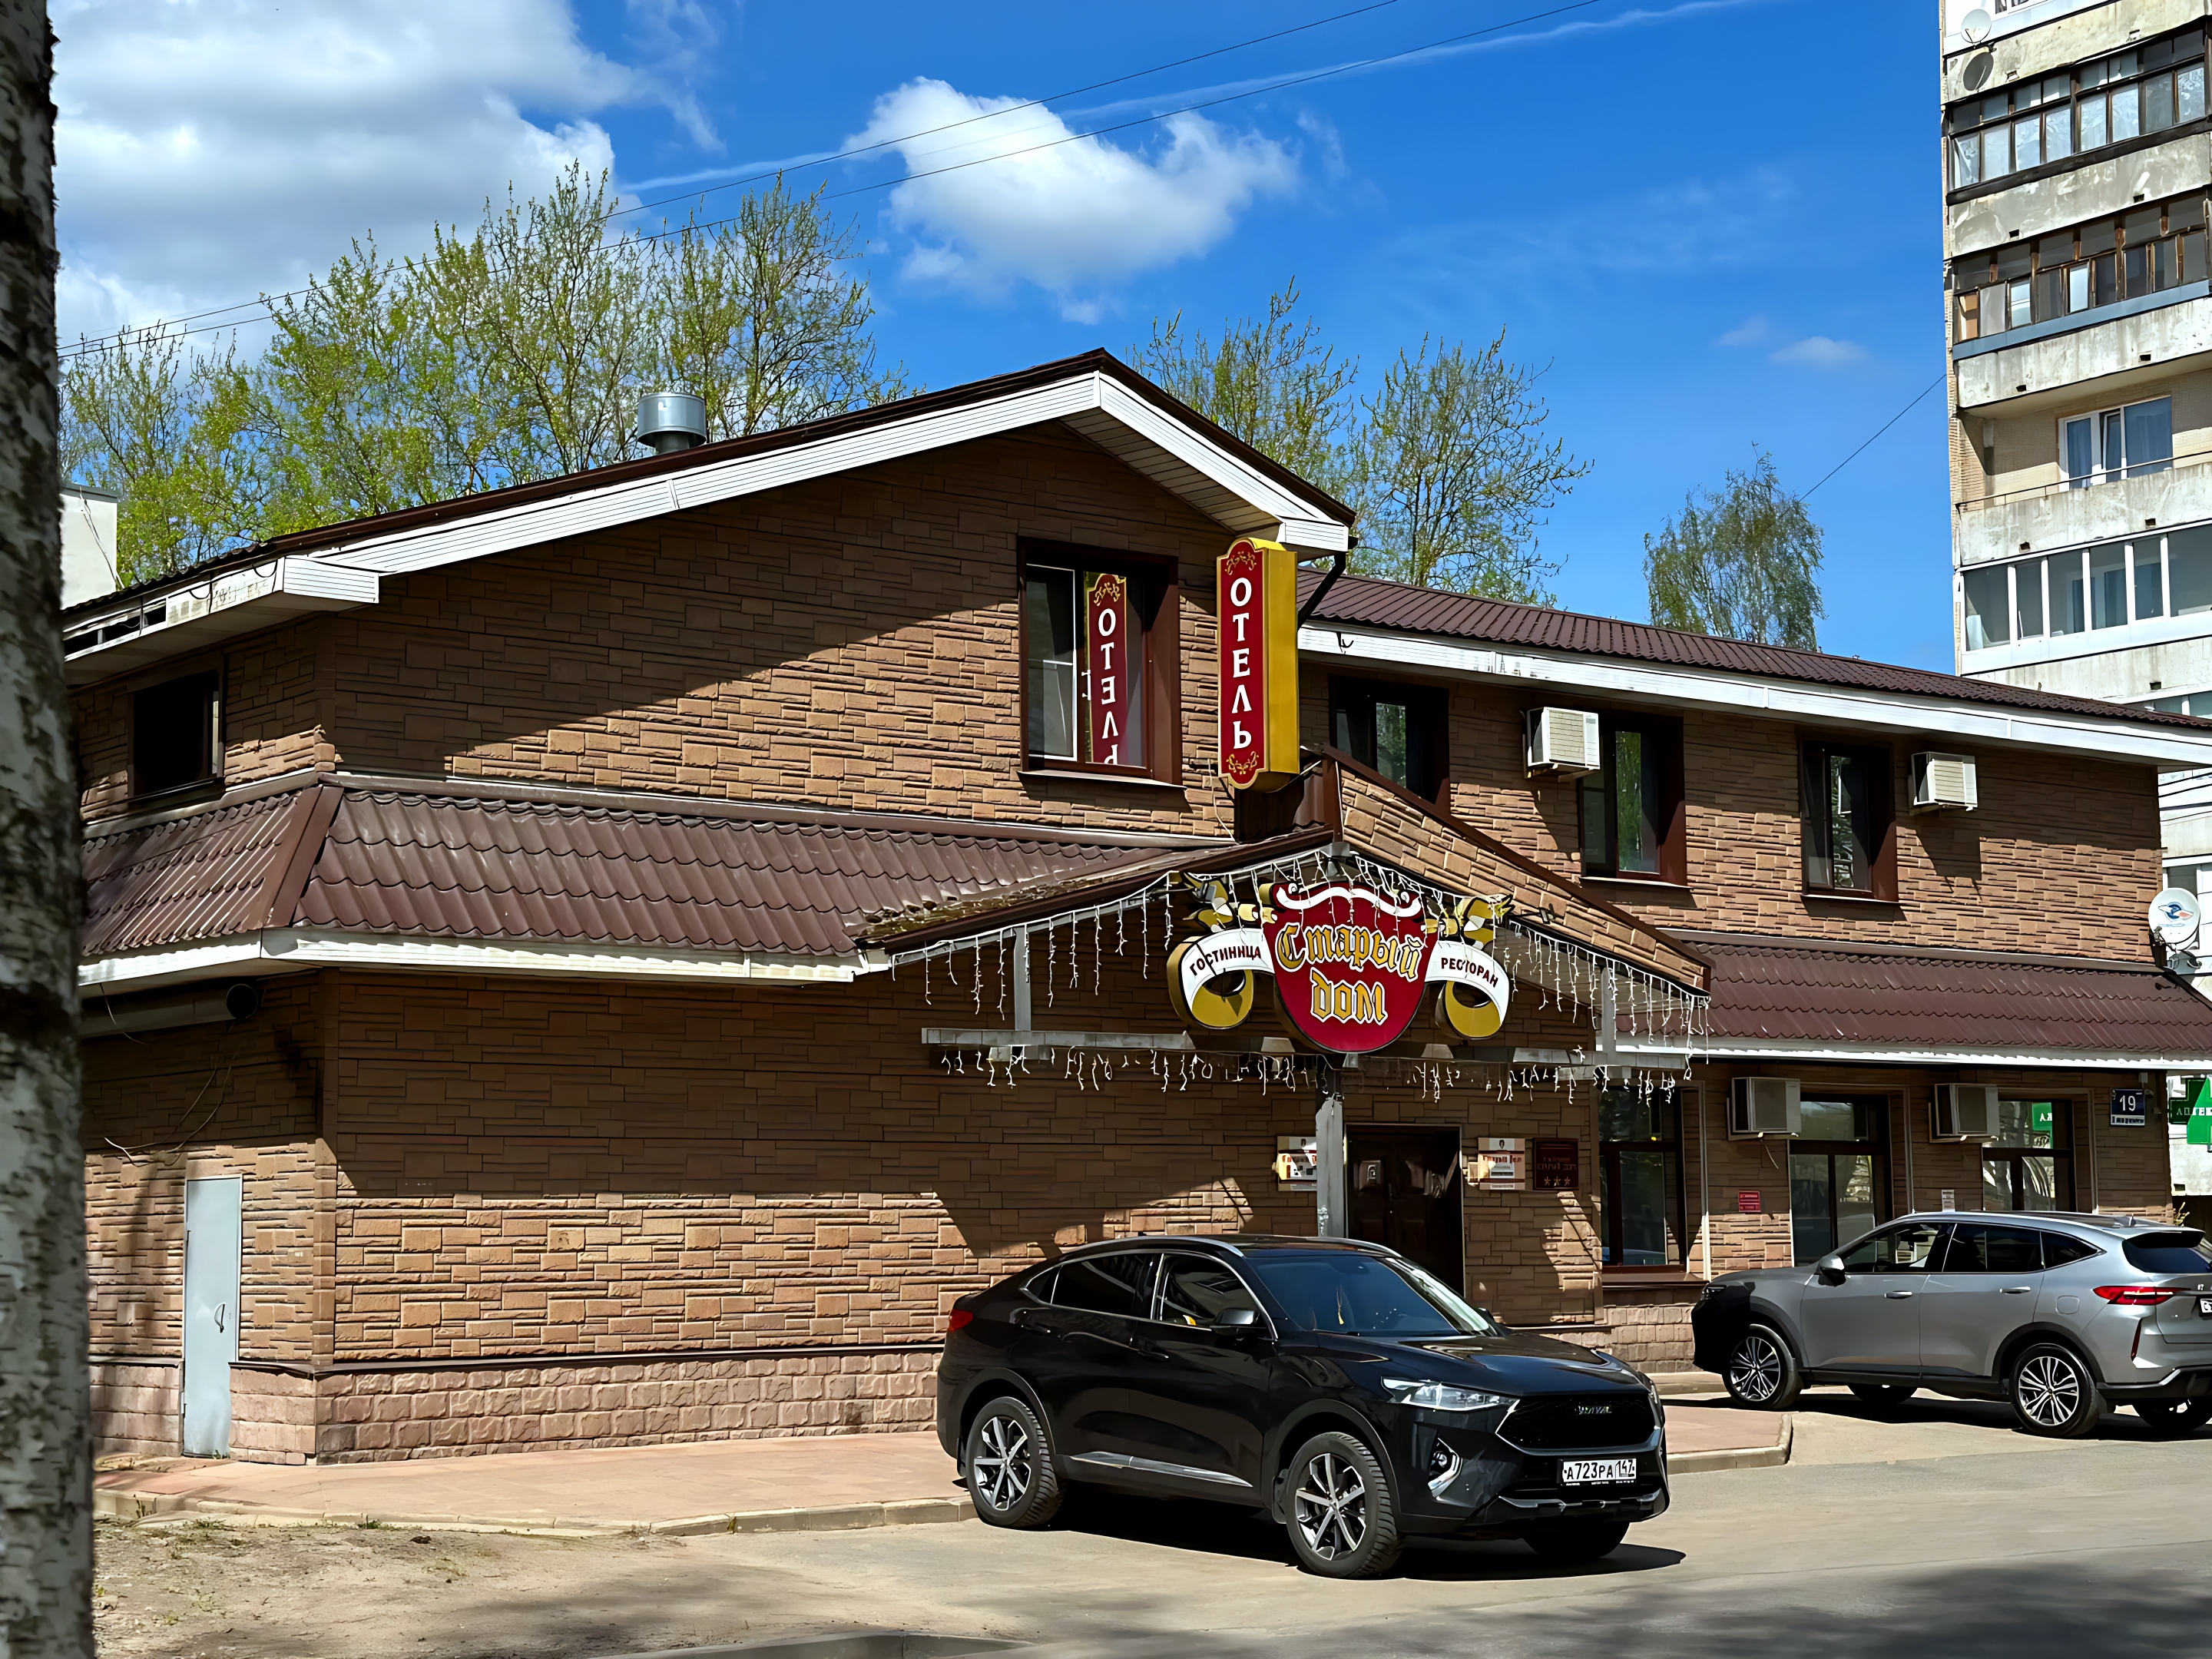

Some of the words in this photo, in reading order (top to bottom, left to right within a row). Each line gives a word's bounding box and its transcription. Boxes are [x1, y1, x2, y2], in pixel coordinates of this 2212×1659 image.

[1230, 577, 1253, 750] ОТЕЛЬ
[1277, 923, 1423, 982] Старый
[1441, 957, 1498, 988] РЕСТОРАН
[2119, 1094, 2136, 1111] 19
